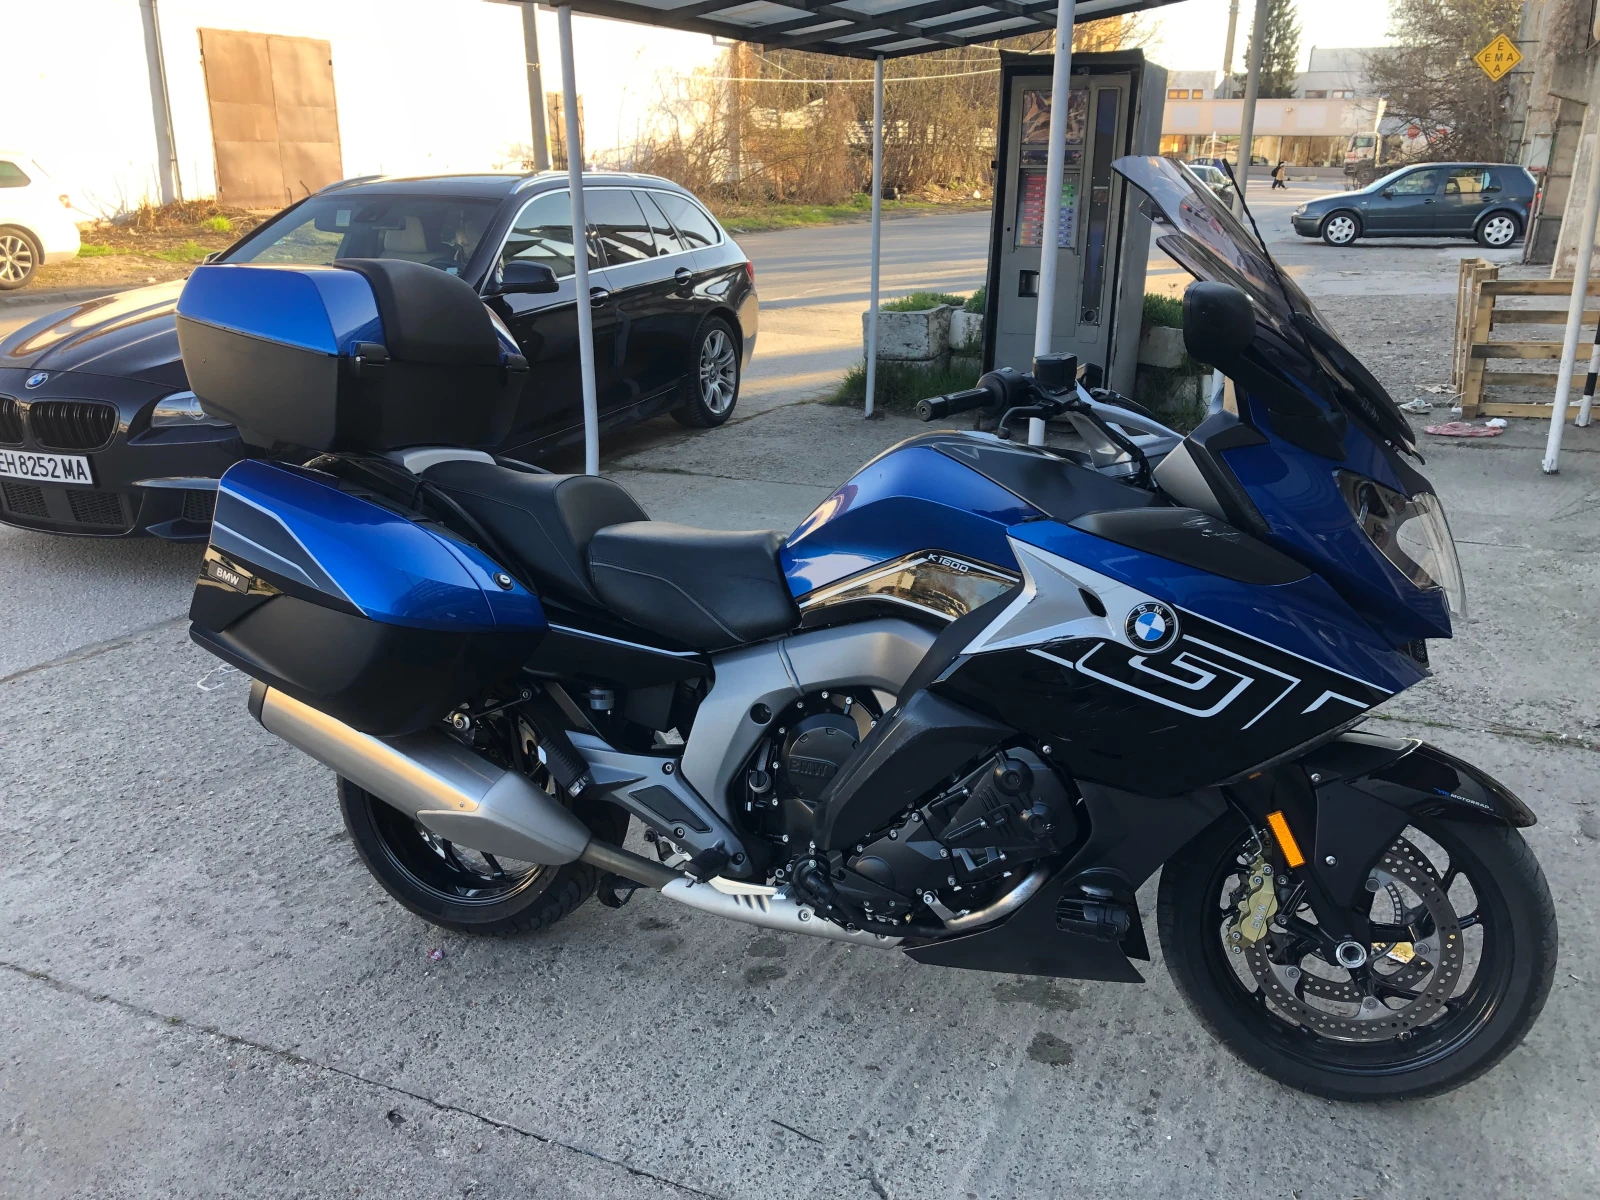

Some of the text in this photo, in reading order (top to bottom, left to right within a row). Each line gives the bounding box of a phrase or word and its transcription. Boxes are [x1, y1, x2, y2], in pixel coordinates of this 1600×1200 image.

[18, 454, 61, 478] 8252
[61, 458, 88, 481] MA
[928, 553, 969, 573] K 1600
[216, 567, 240, 585] BMW
[789, 760, 828, 777] BMW
[1450, 793, 1489, 809] MOTORRAD
[1252, 903, 1267, 929] BMW
